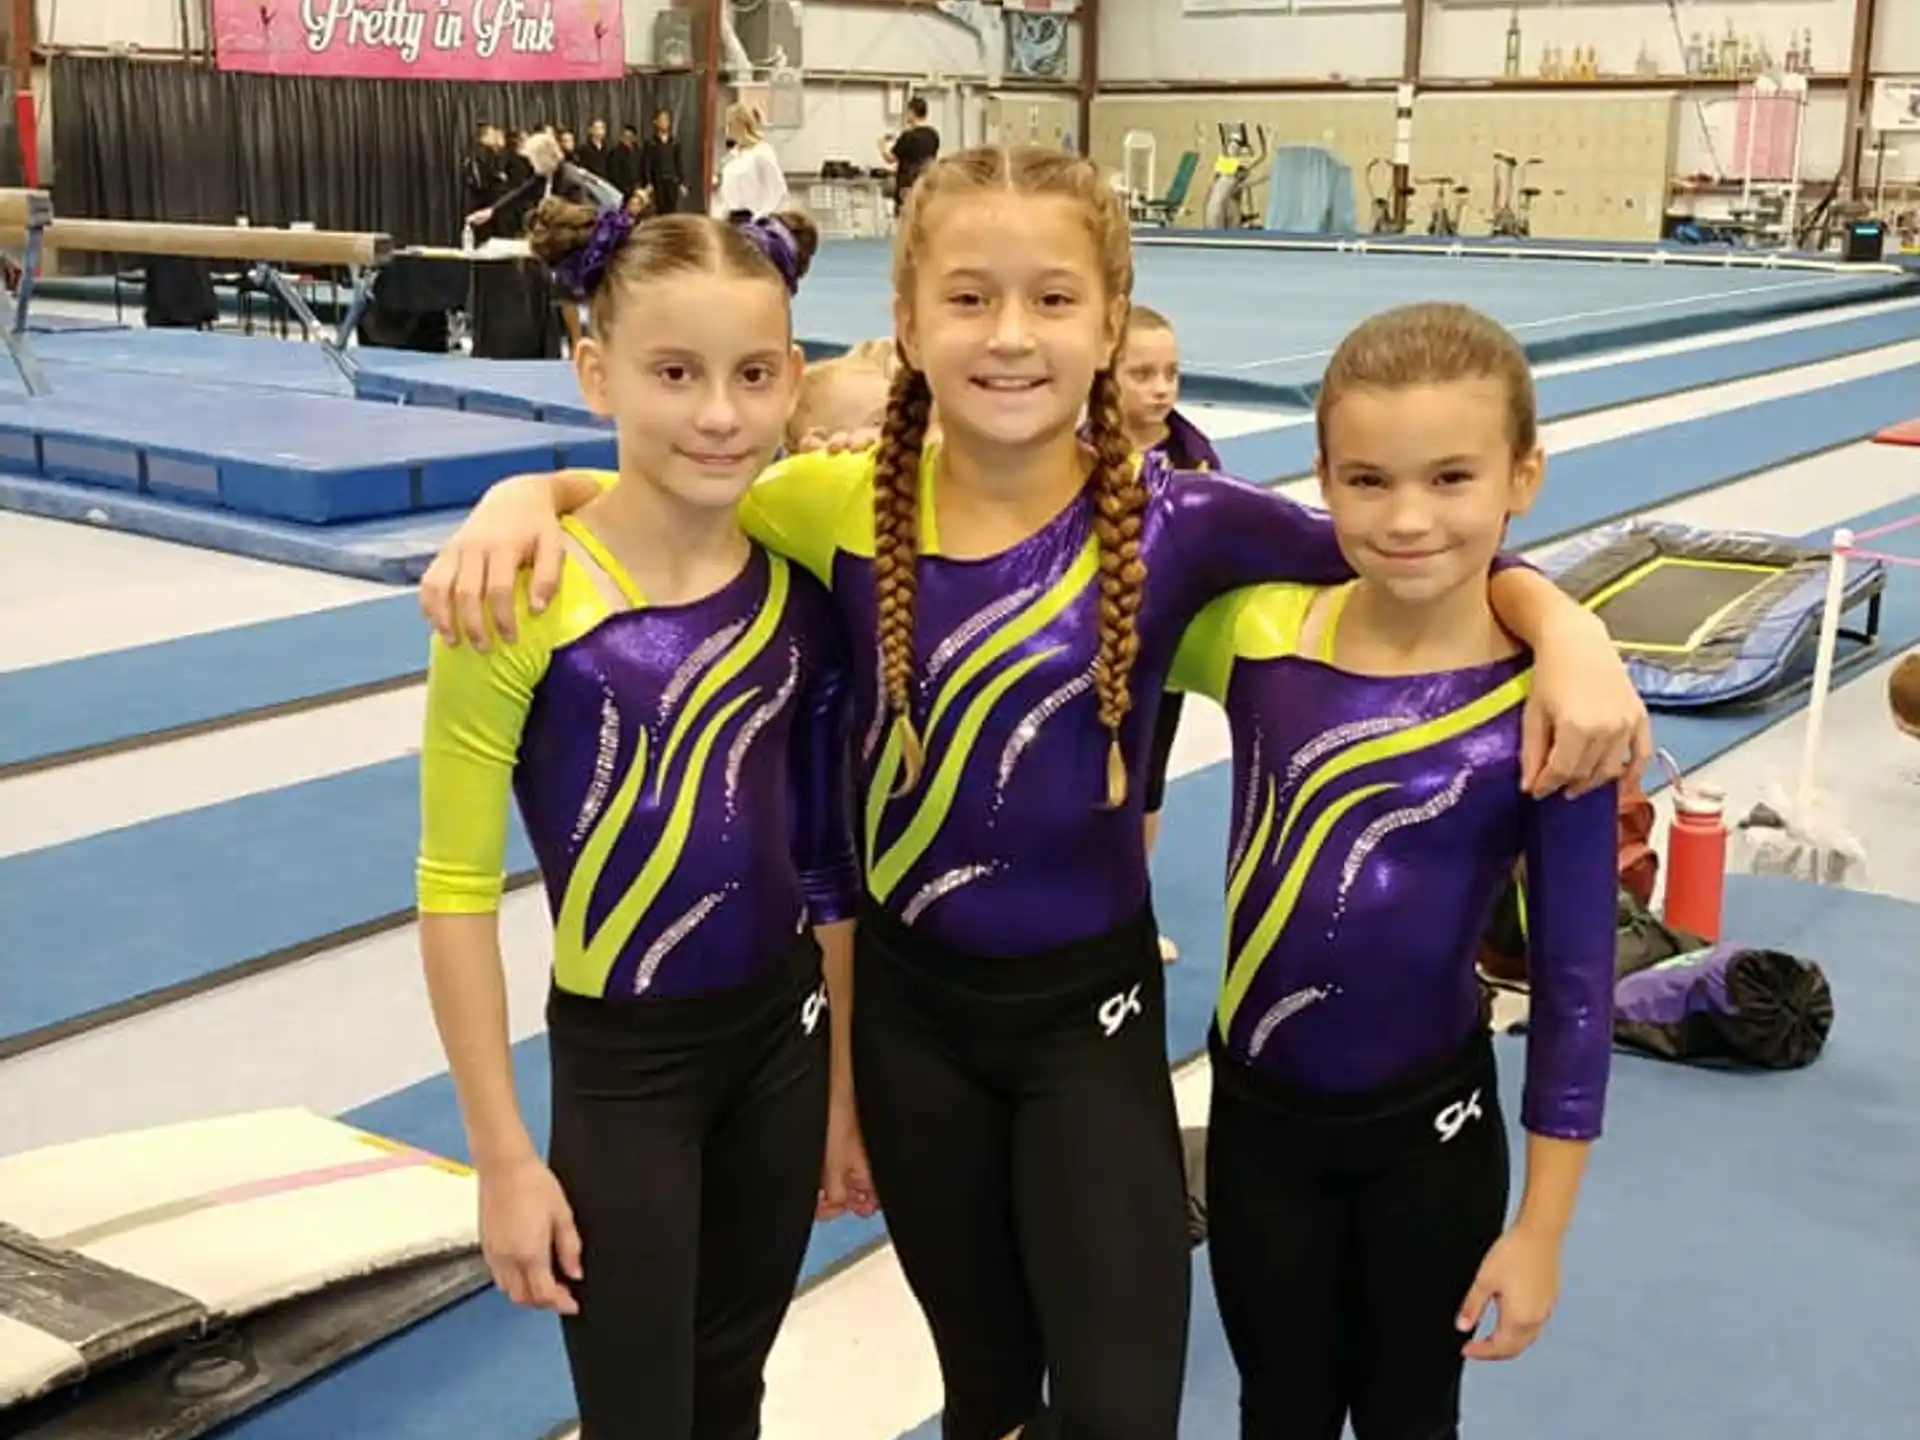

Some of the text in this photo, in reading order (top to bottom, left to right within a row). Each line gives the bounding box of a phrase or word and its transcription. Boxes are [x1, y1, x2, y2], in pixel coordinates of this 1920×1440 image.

[302, 0, 556, 62] Pretty in Pink
